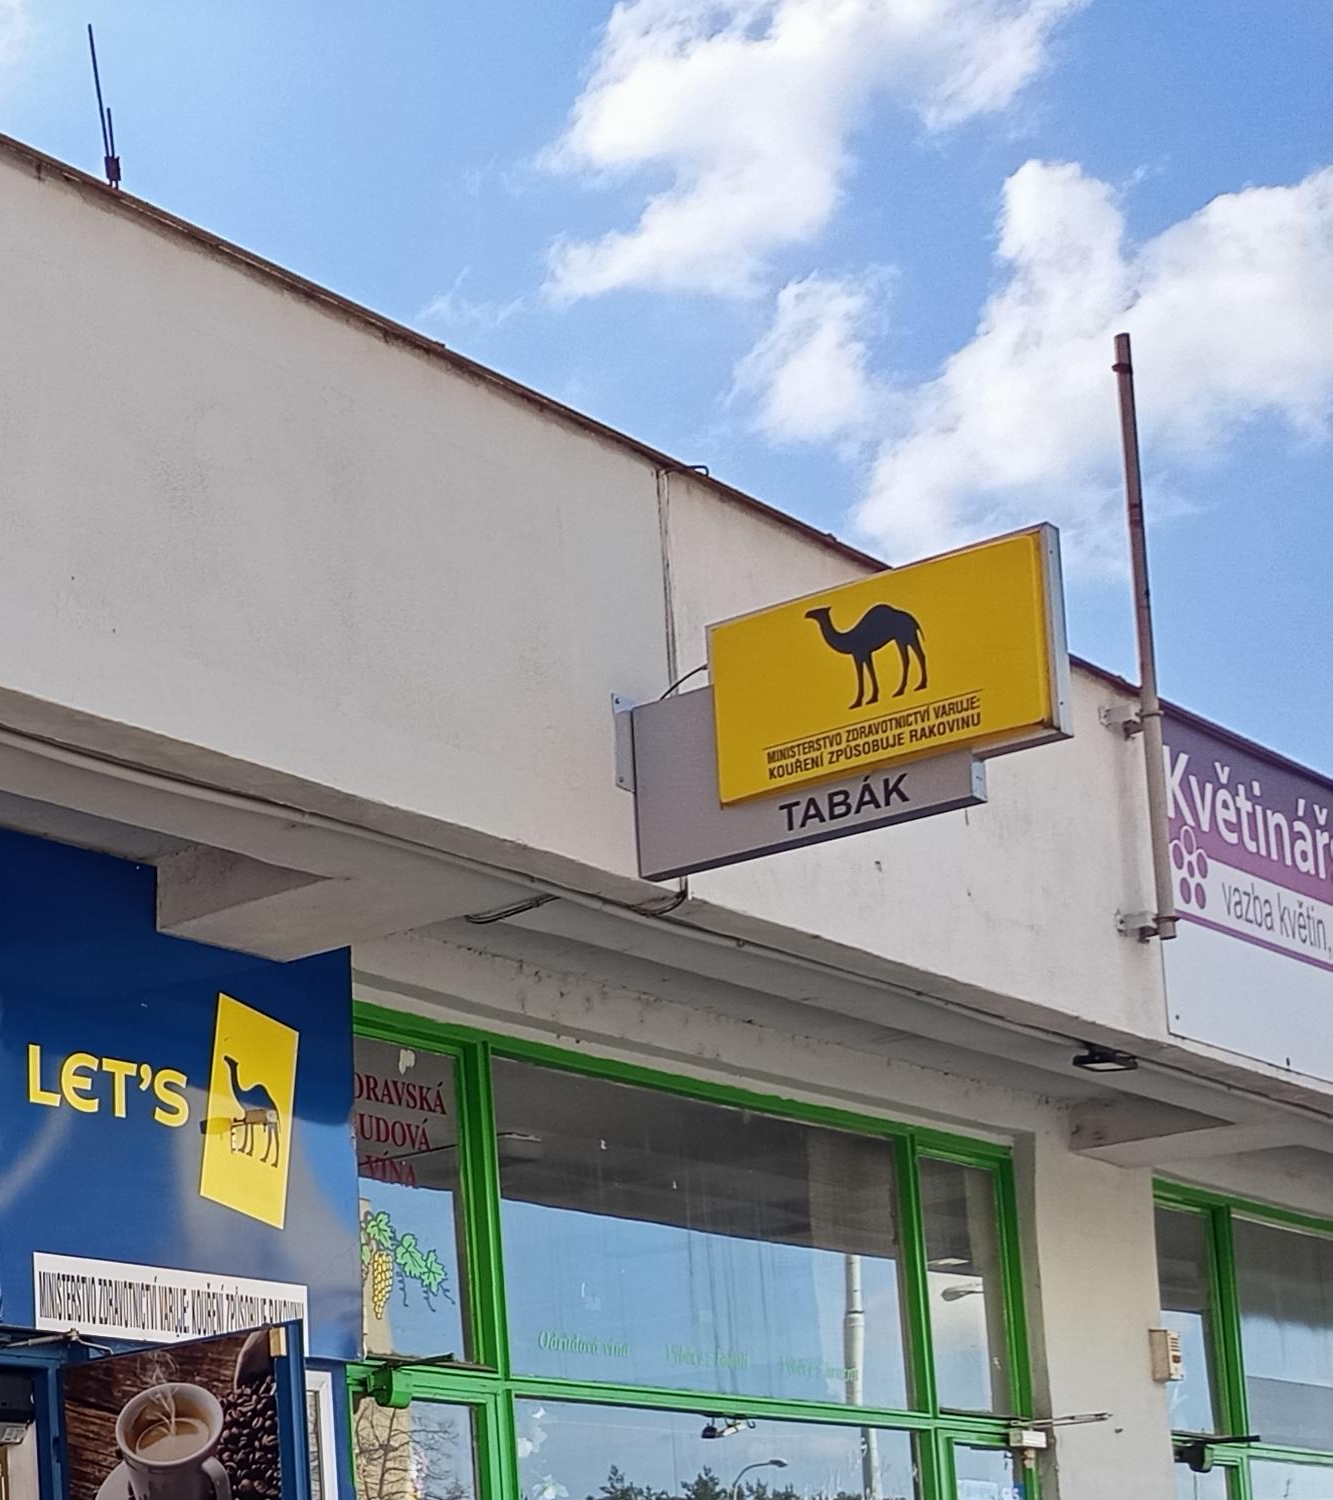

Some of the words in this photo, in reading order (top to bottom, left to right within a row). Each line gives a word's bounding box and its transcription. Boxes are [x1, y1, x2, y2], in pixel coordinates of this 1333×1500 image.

[766, 731, 843, 764] MINISTERSTVO
[845, 708, 931, 743] ZDRAVOTNICTVÍ
[768, 754, 824, 780] KOUŘENÍ
[827, 735, 905, 765] ZPŮSOBUJE
[909, 712, 981, 743] RAKOVINU
[778, 772, 910, 832] TABÁK
[1162, 744, 1333, 880] Květinář
[1222, 882, 1275, 933] vazba
[39, 1271, 96, 1324] MINISTERSTVO
[98, 1276, 158, 1331] ZDRAVOTNICTVÍ
